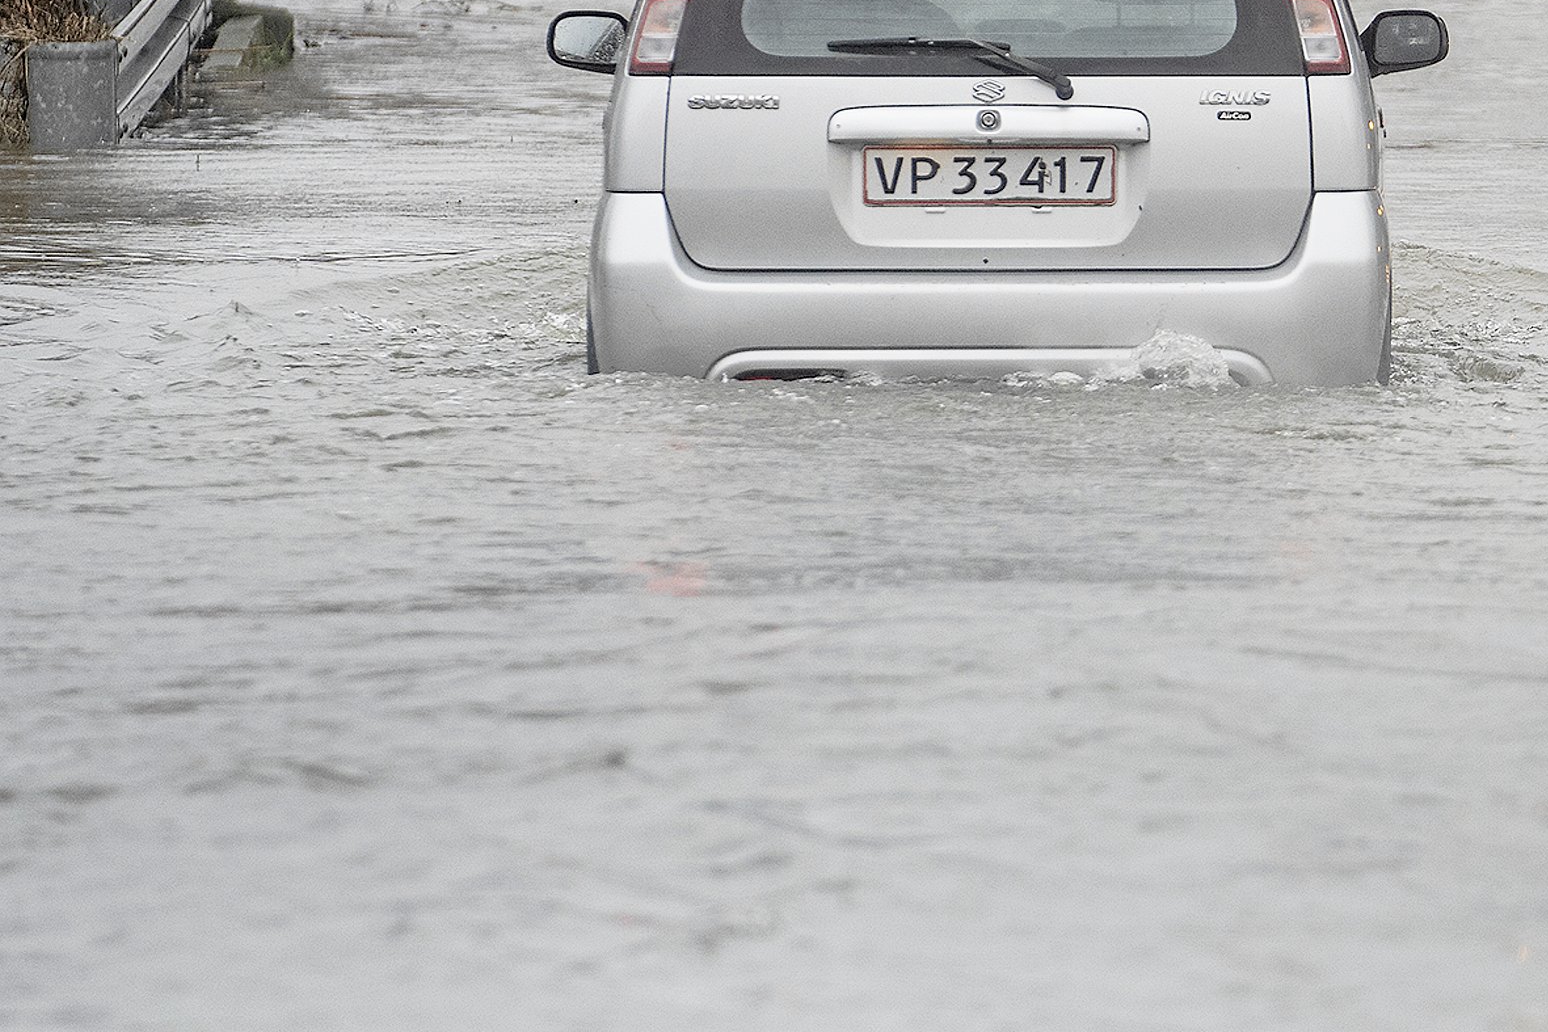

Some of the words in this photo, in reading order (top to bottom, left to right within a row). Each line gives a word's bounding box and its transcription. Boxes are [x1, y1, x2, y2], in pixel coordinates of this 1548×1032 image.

[687, 94, 780, 109] SUZUKI
[1199, 89, 1272, 106] IGNIS
[874, 156, 941, 195] VP
[952, 156, 1008, 195] 33
[1019, 155, 1106, 194] 417
